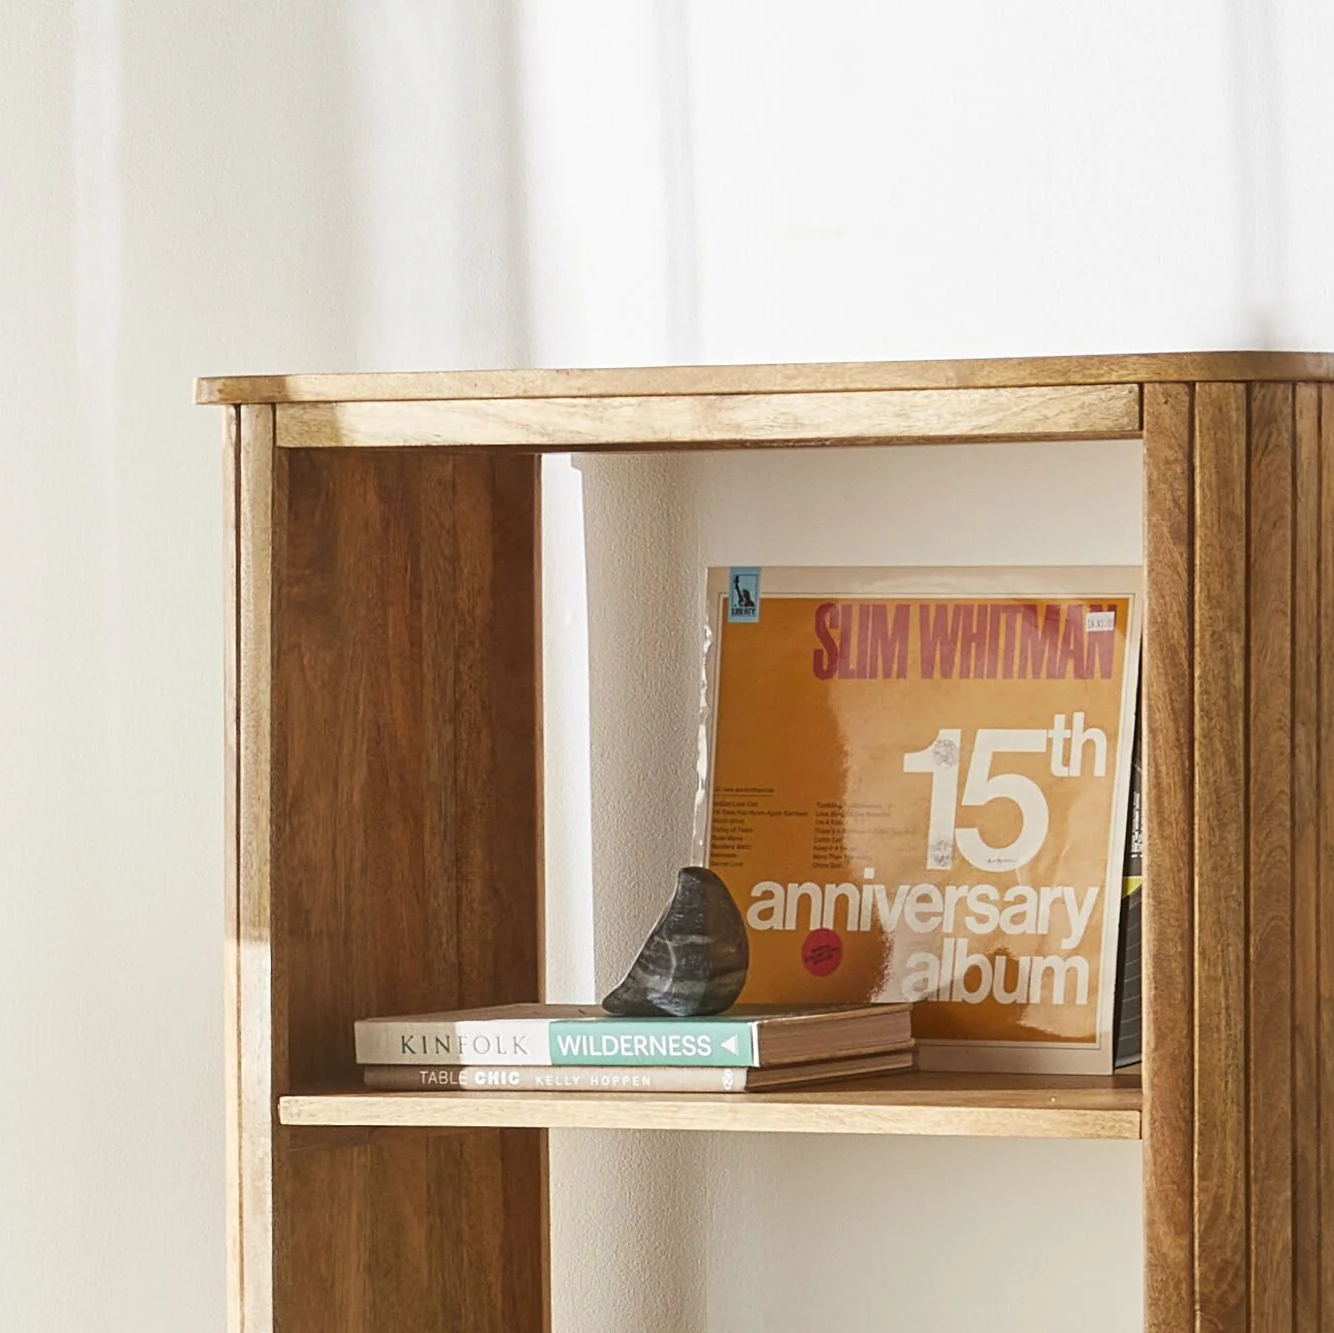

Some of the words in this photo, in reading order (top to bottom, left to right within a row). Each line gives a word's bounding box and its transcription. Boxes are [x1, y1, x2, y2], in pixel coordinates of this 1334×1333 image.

[813, 602, 910, 681] SLIM
[919, 603, 1117, 680] WHITMAN
[903, 711, 1108, 873] 15th
[746, 867, 1099, 949] anniversary
[901, 937, 1090, 1006] album
[400, 1035, 530, 1055] KINFOLK
[556, 1034, 712, 1057] WILDERNESS
[419, 1070, 468, 1085] TABLE
[474, 1071, 521, 1086] CHIC
[534, 1074, 581, 1087] KELLY
[590, 1075, 652, 1087] HOPPEN
